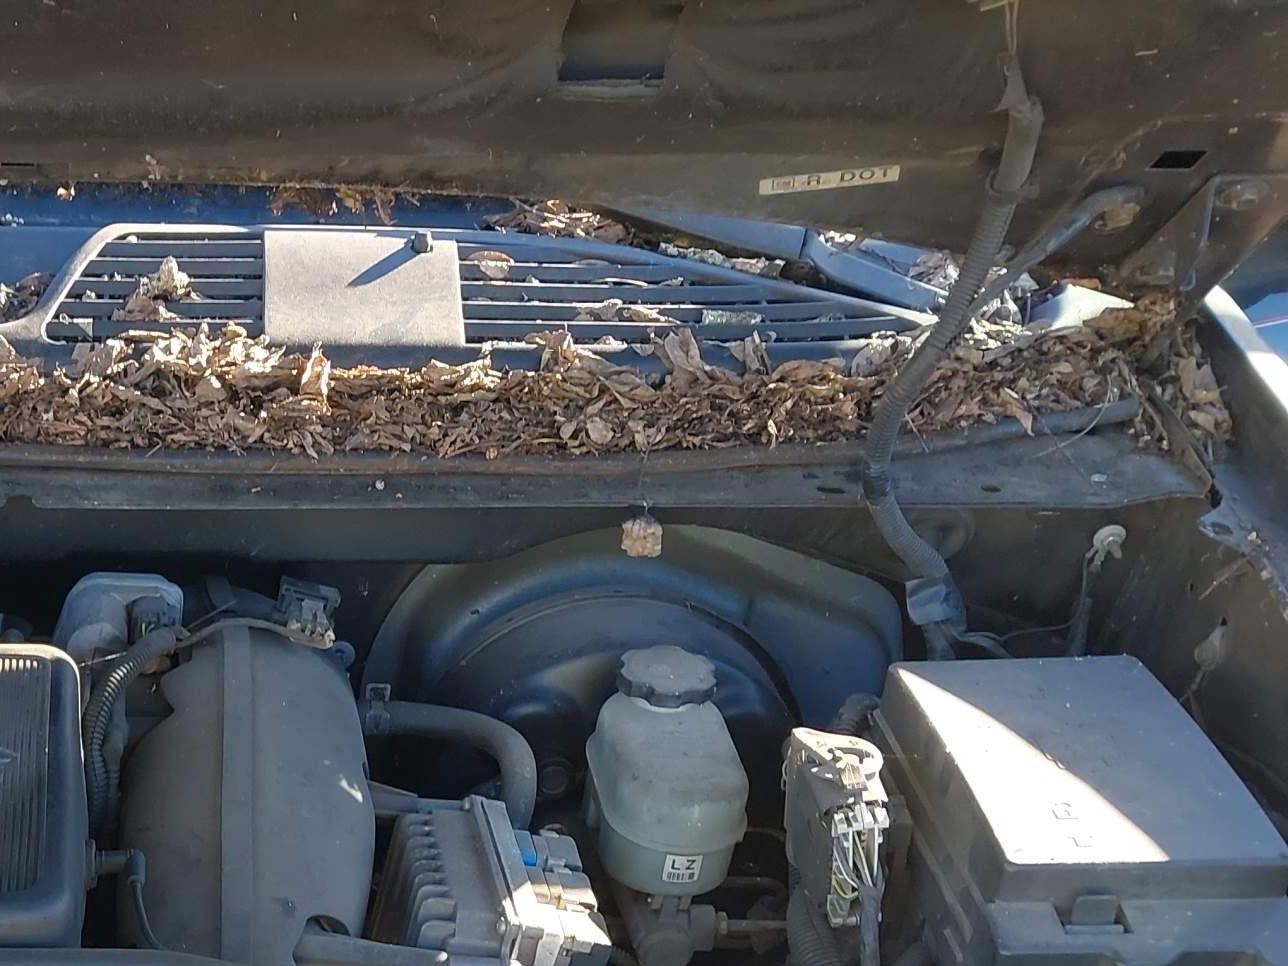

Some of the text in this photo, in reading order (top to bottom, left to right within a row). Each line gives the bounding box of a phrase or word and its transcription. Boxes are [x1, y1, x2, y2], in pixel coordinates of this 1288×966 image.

[840, 167, 891, 183] DOT
[670, 858, 697, 870] L Z
